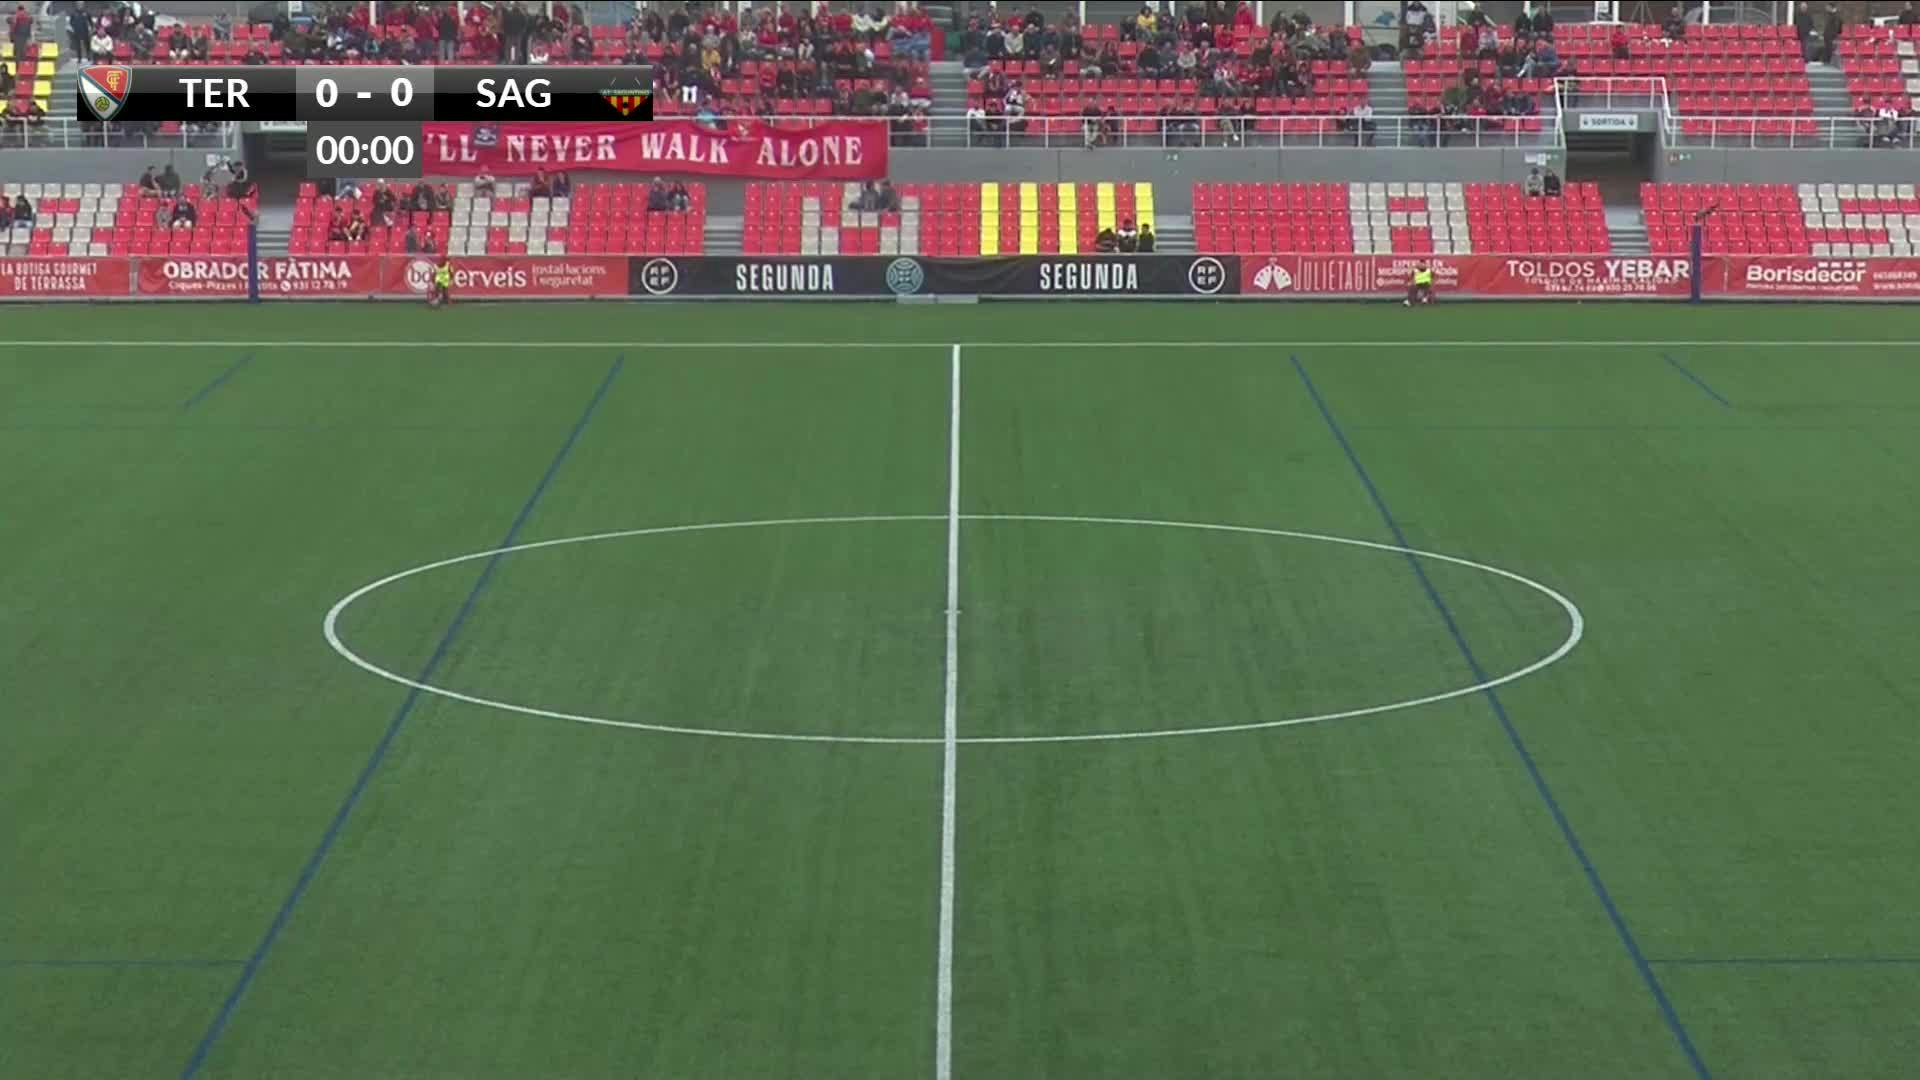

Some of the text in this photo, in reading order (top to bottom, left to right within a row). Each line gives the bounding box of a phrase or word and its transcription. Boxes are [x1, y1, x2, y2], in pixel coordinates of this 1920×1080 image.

[506, 134, 616, 162] NEVER
[640, 132, 729, 164] WALK
[756, 136, 864, 166] ALONE
[163, 261, 270, 280] OBRADOR
[453, 266, 527, 288] erveis
[736, 264, 834, 291] SEGUNDA
[1040, 263, 1138, 290] SEGUNDA
[1507, 260, 1690, 278] TOLDOS YEBAR
[1746, 265, 1866, 282] Borisdecor
[15, 276, 86, 291] DE TERRASSA
